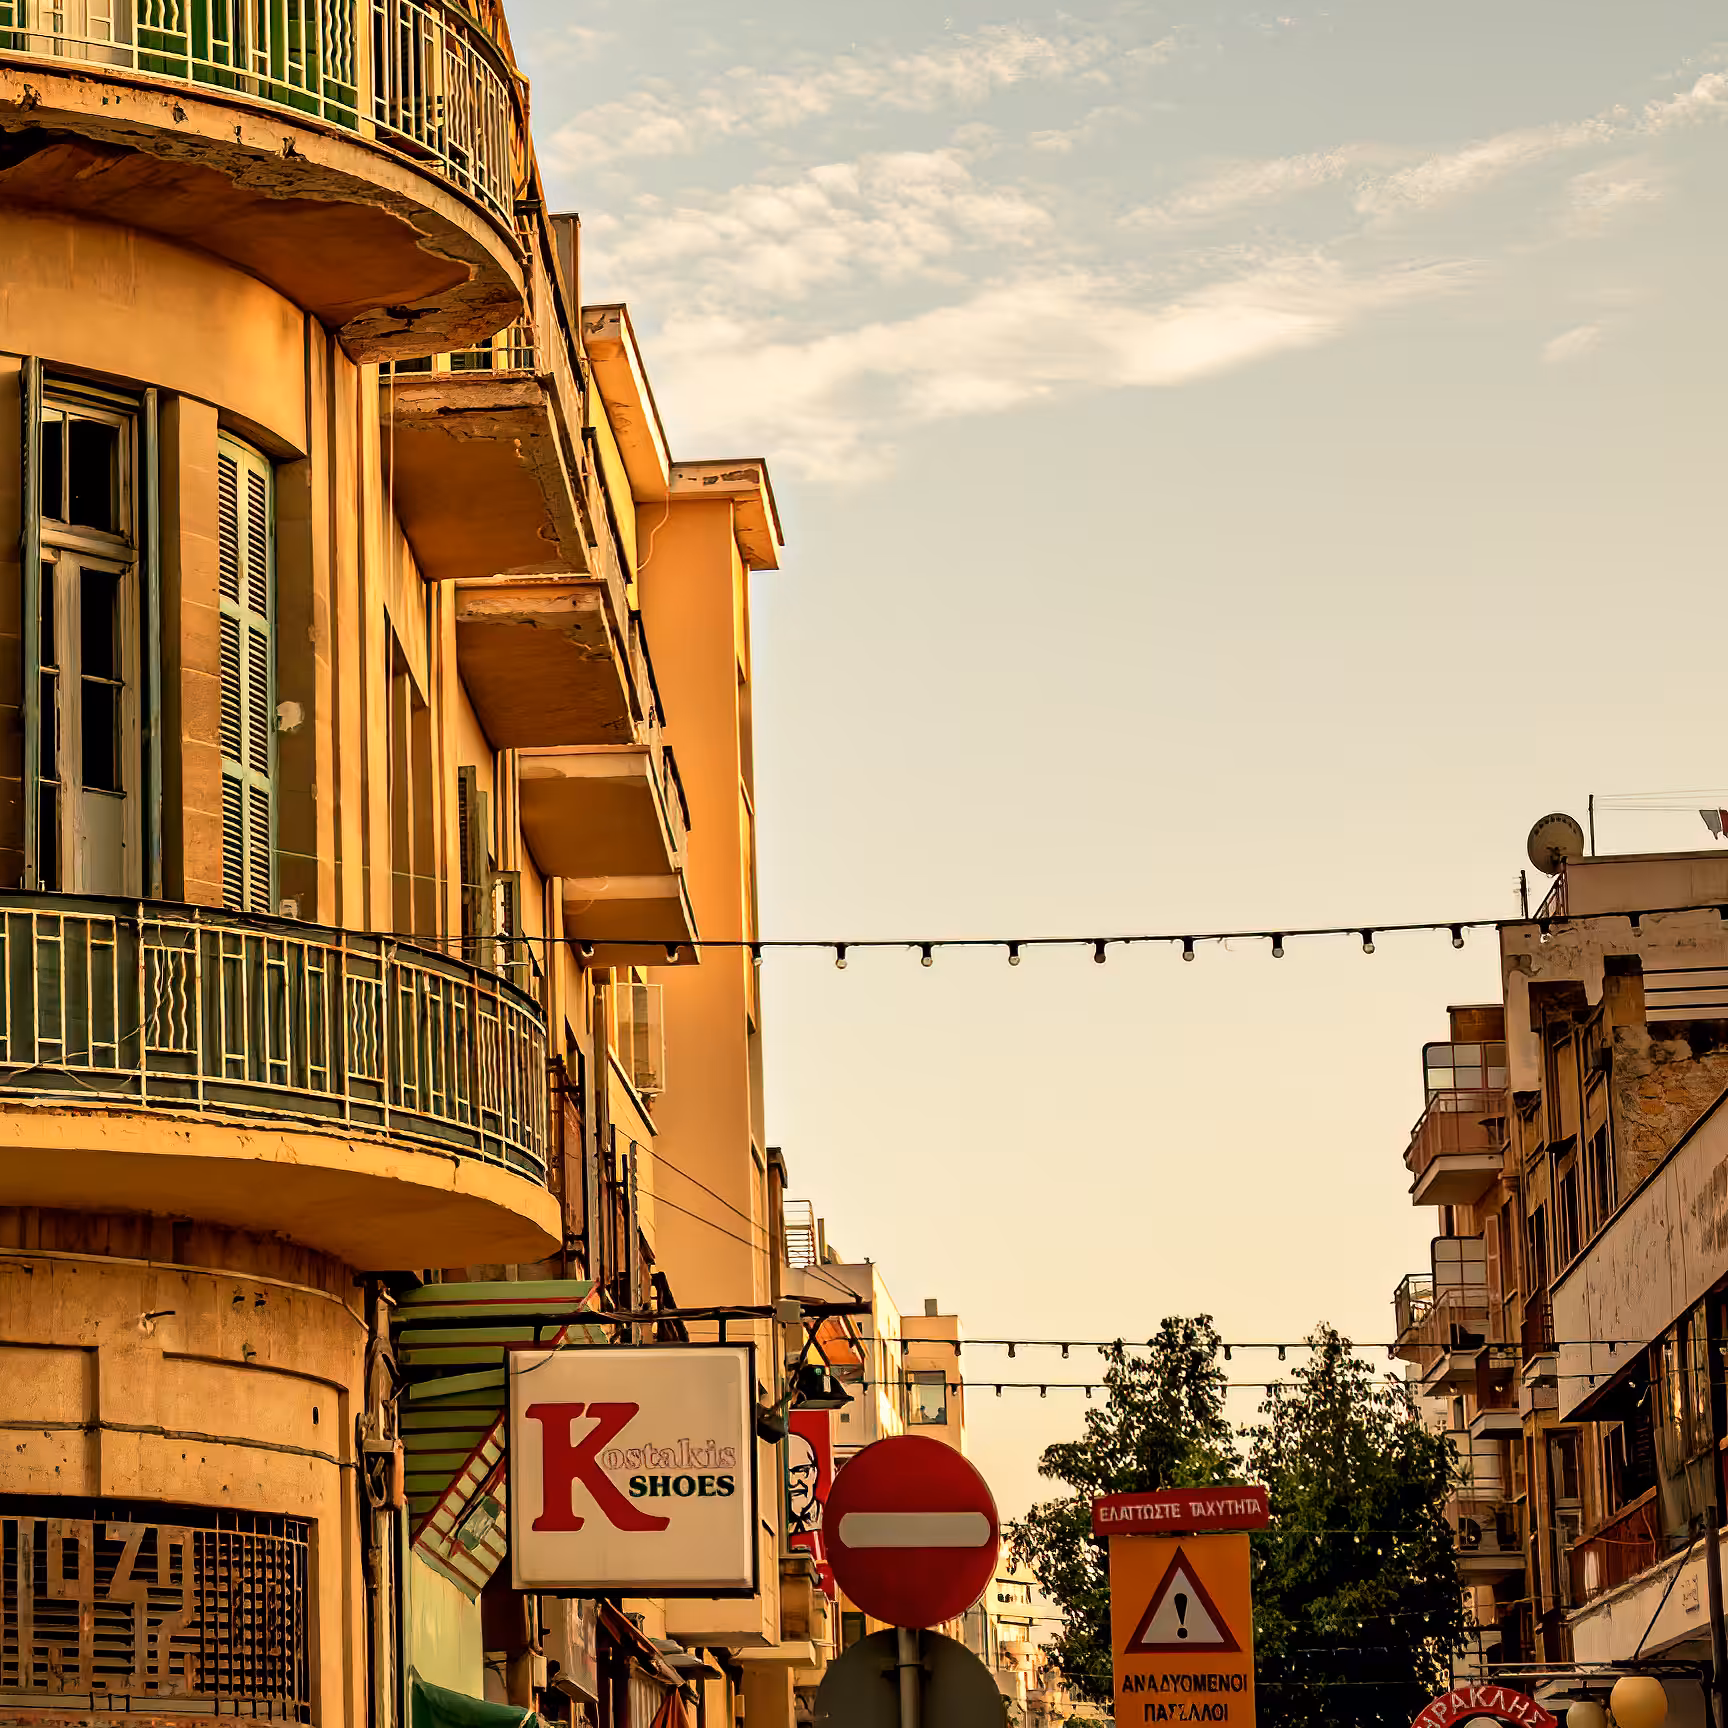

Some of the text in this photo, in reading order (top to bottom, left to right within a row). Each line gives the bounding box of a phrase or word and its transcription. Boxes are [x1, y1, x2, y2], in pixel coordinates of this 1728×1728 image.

[526, 1402, 736, 1531] Kostakis
[629, 1474, 734, 1497] SHOES
[1100, 1498, 1261, 1522] ΕΛΑΤΤΩΣΤΕ ΤΑΧΥΤΗΤΑ
[1122, 1673, 1248, 1694] ΑΝΑΔΥΟΜΕΝΟΙ
[1143, 1702, 1228, 1723] ΠΑΣΣΑΛΟΙ
